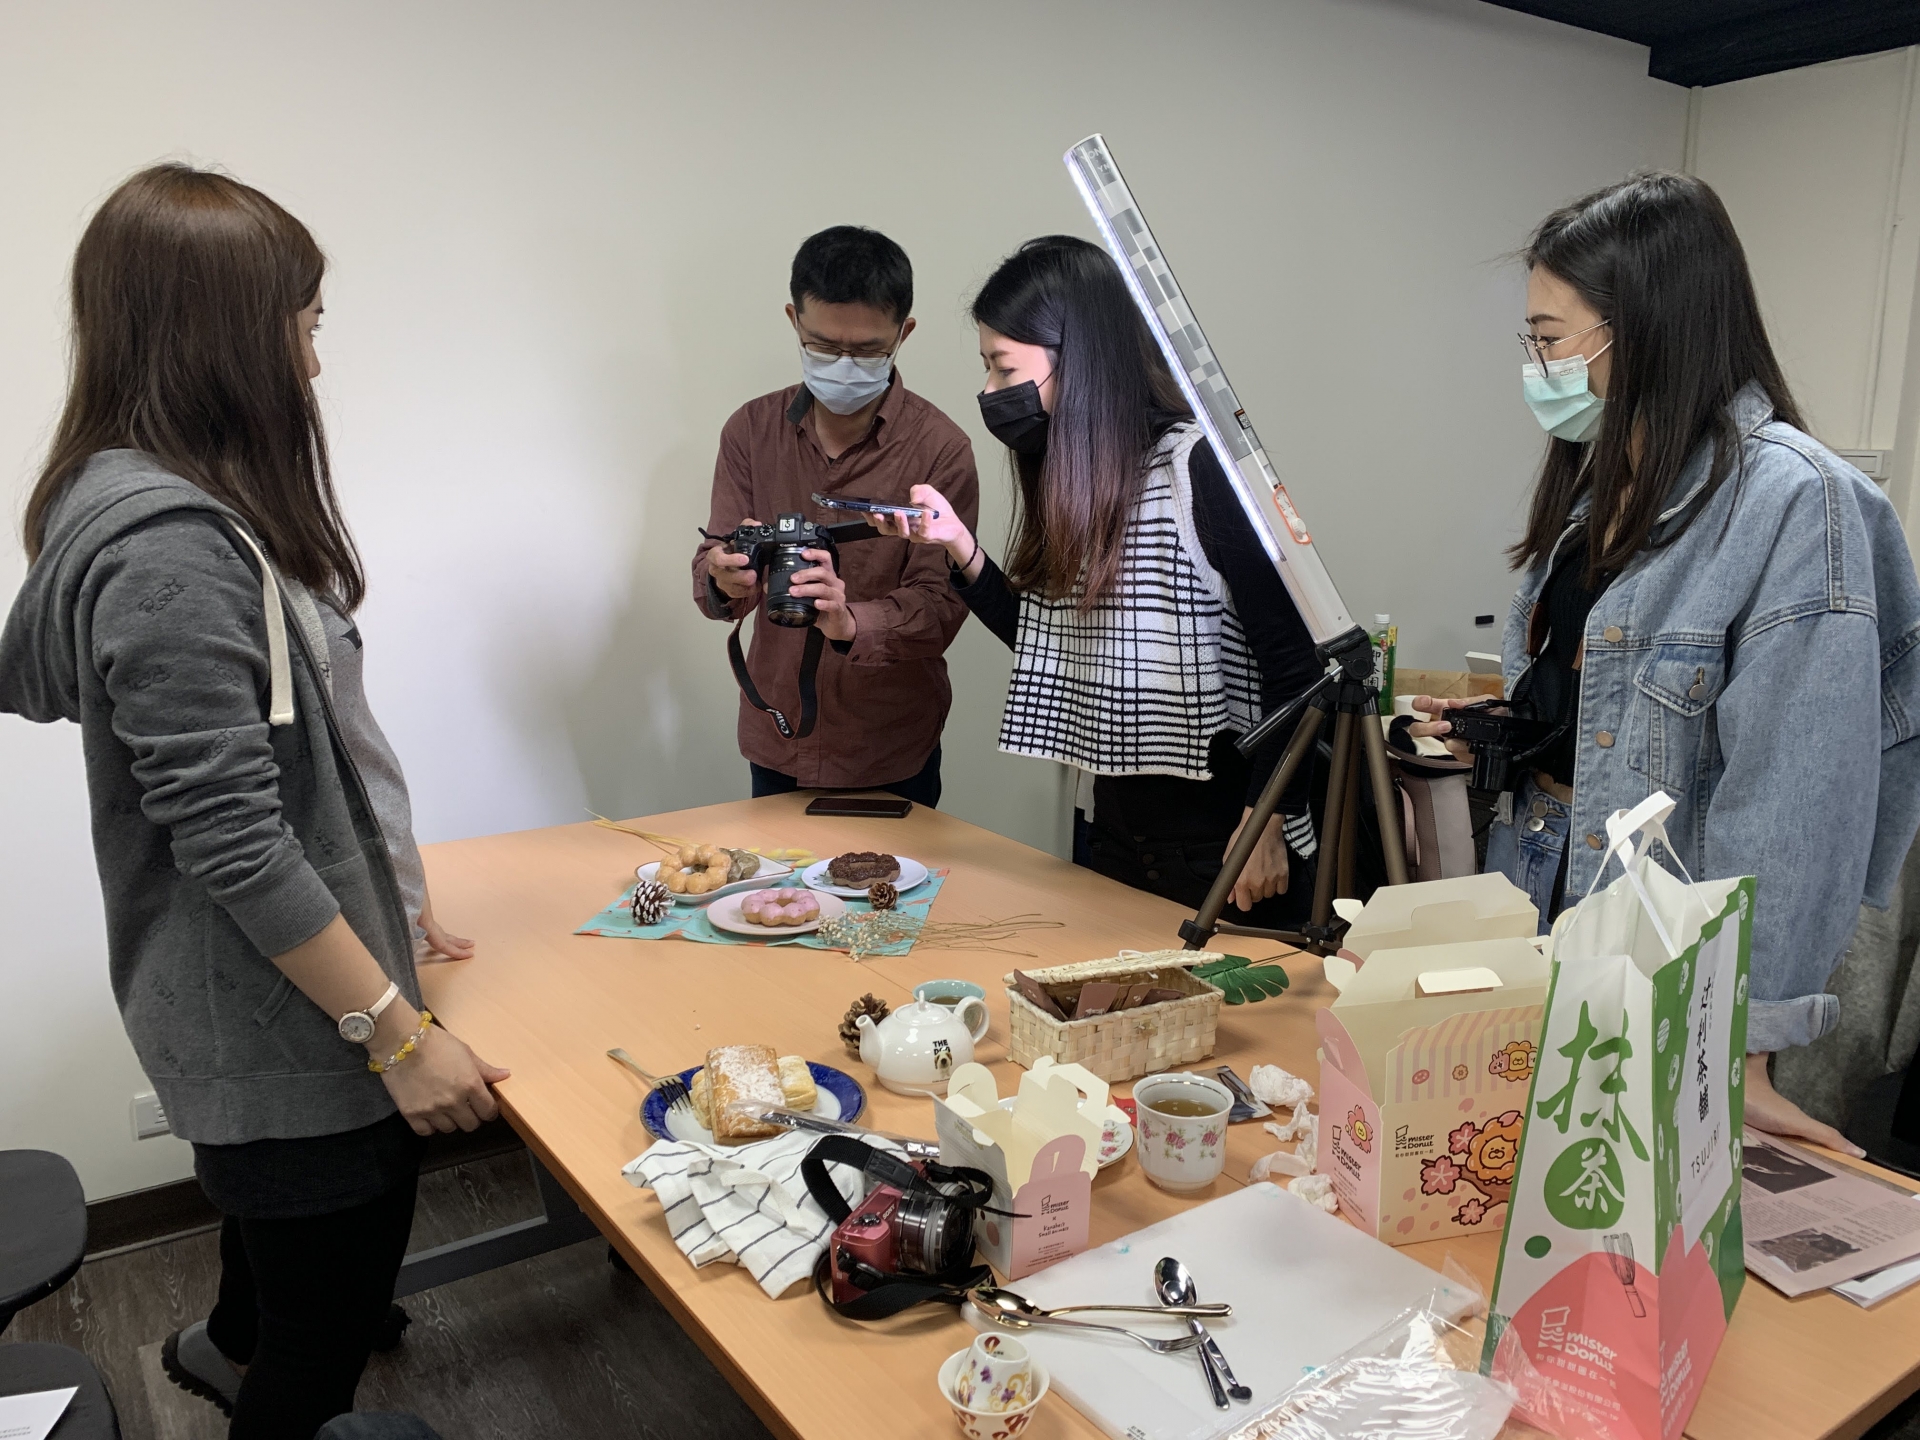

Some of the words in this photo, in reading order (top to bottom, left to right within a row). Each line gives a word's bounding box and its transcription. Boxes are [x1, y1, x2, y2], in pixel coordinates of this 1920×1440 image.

[932, 1039, 949, 1048] THE
[1536, 1000, 1650, 1213] 抹茶
[1407, 1140, 1434, 1150] Donut
[1408, 1134, 1434, 1143] mister
[882, 1203, 896, 1220] SONY
[1566, 1332, 1618, 1360] mister
[1564, 1342, 1616, 1375] Donut
